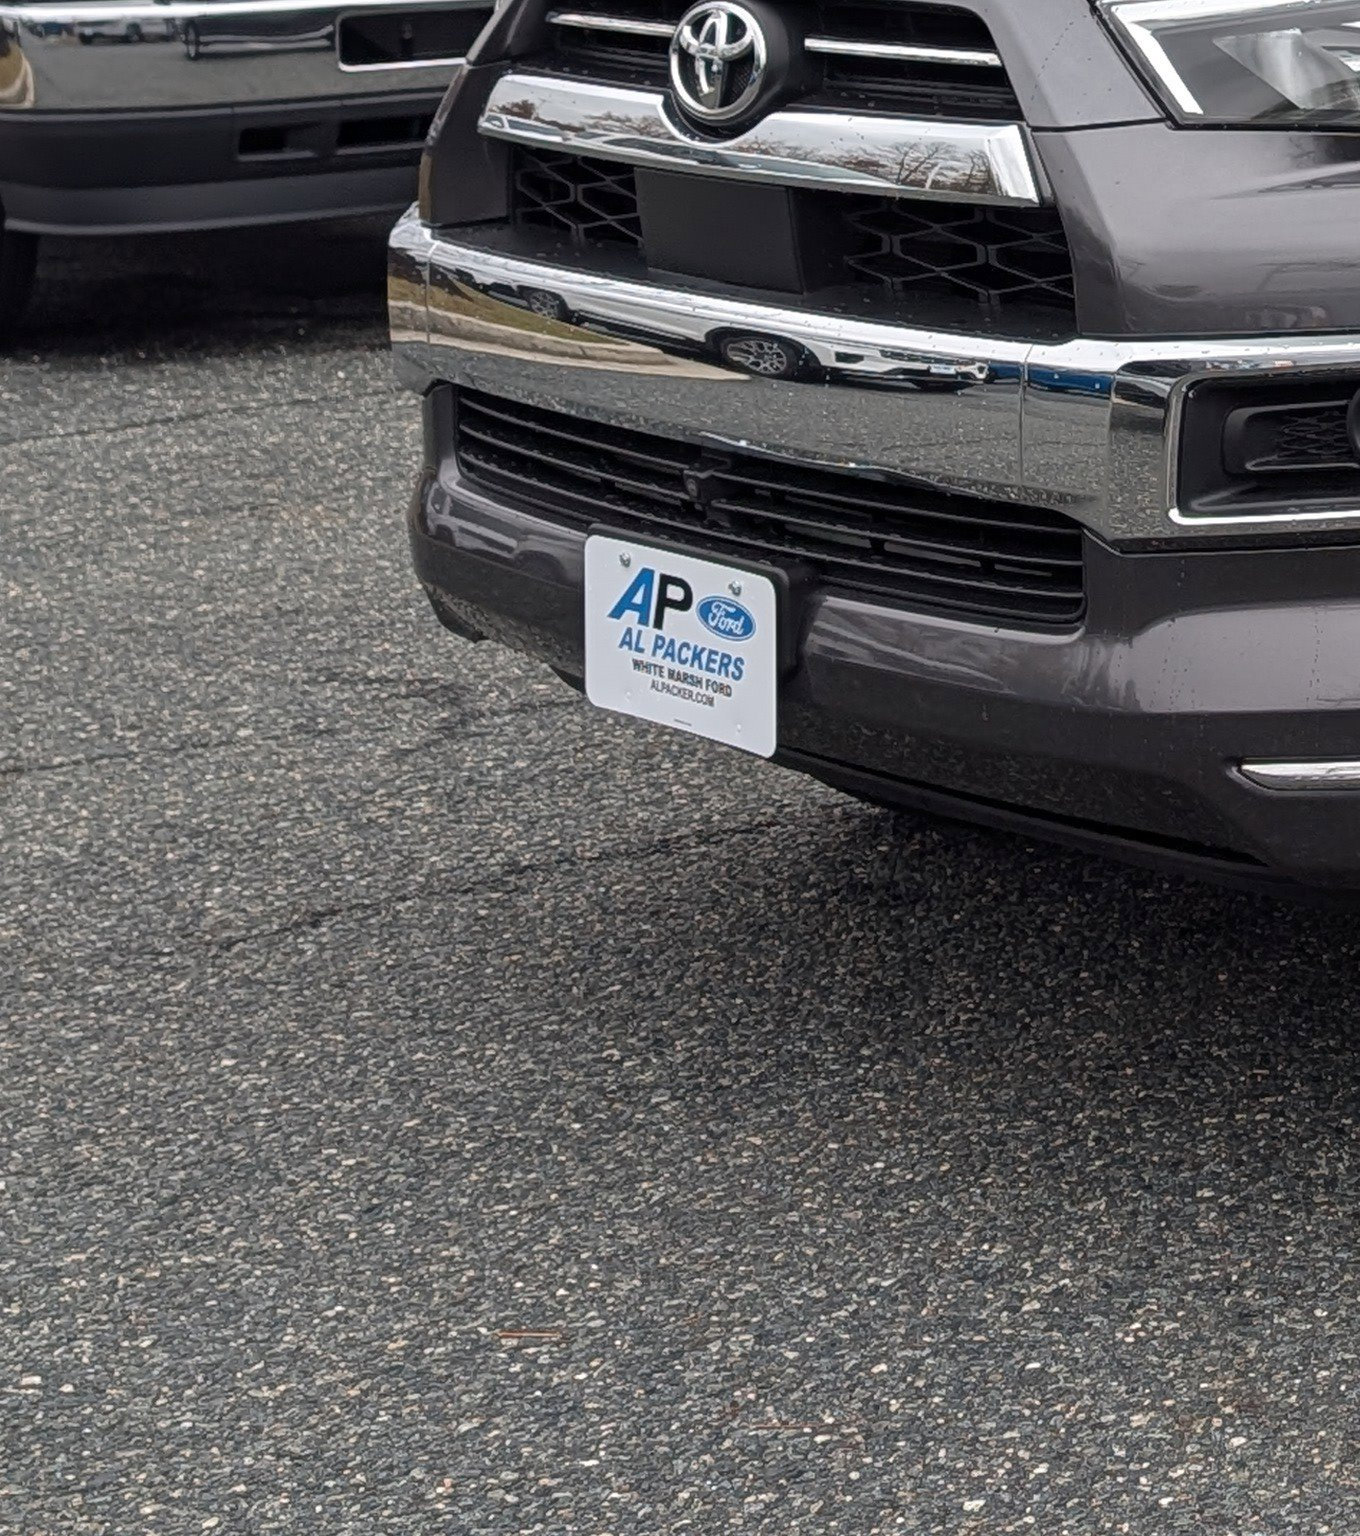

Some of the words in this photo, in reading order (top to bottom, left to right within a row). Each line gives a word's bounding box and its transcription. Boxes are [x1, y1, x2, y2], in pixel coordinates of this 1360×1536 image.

[606, 566, 693, 631] AP
[707, 601, 746, 635] Ford
[617, 626, 646, 654] AL
[651, 633, 746, 682] PACKERS
[631, 657, 665, 679] WHITE
[667, 667, 703, 690] MARSH
[704, 677, 733, 698] FORD
